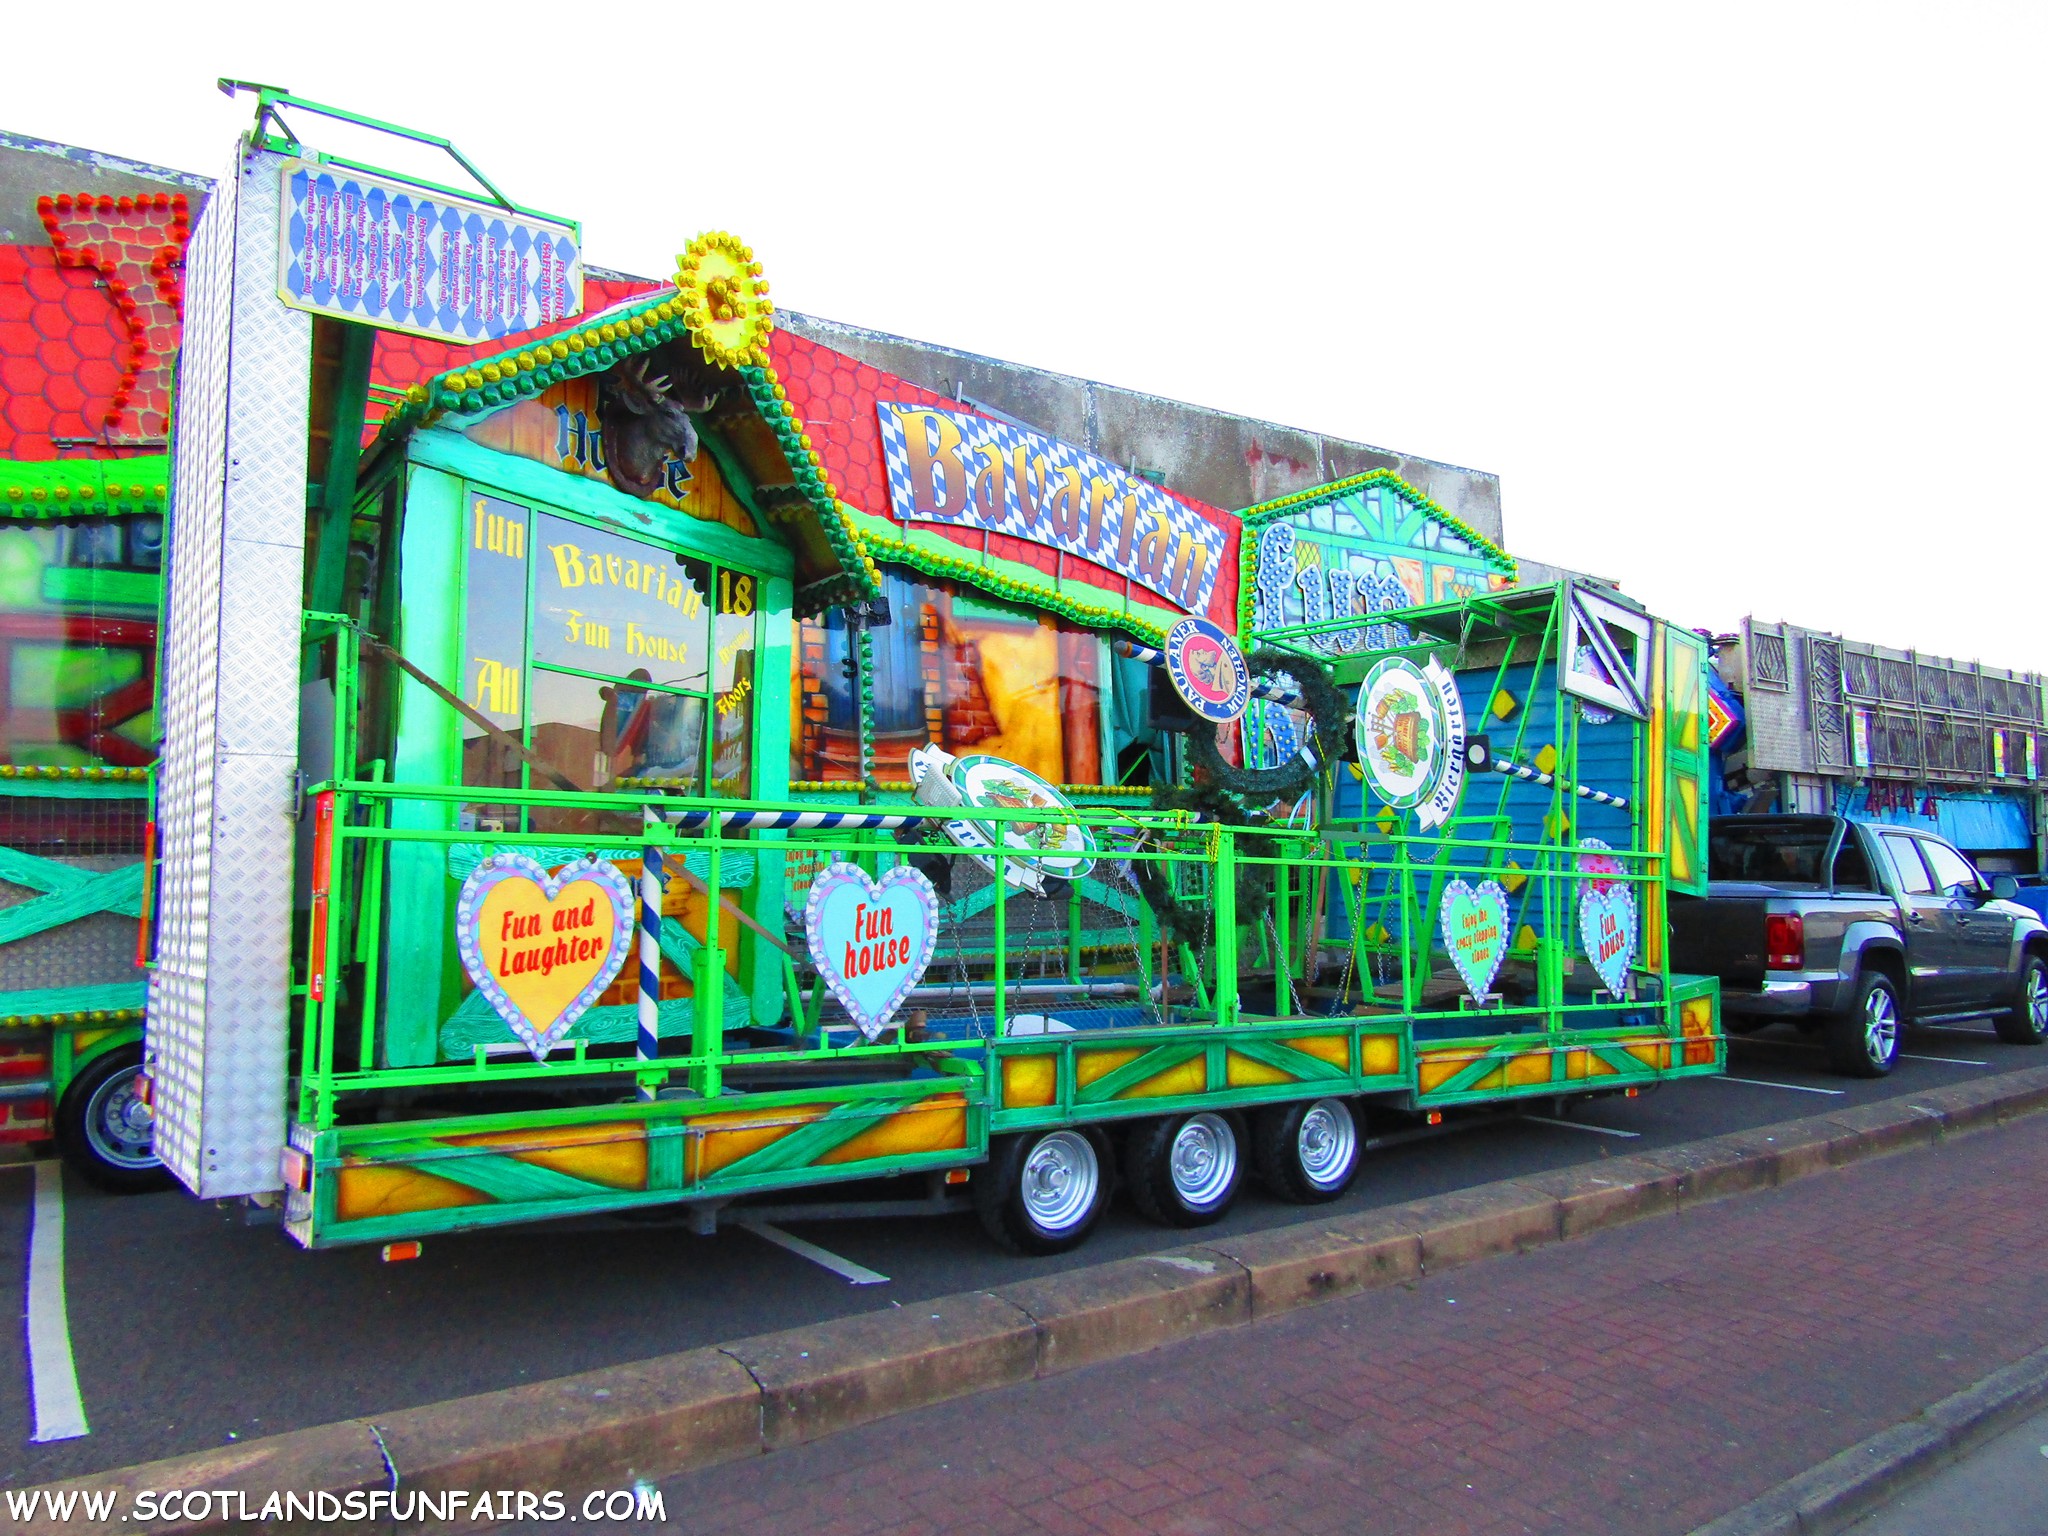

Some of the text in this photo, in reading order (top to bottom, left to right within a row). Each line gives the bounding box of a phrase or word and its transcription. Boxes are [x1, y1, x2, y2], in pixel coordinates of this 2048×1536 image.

[542, 242, 552, 292] SAFETY
[555, 260, 565, 285] FUN
[891, 404, 1207, 607] Bavarian
[474, 500, 524, 560] fun
[548, 543, 702, 620] Bavarian
[721, 571, 752, 617] 18
[565, 609, 610, 649] Fun
[468, 657, 519, 715] All
[1169, 620, 1206, 712] PAULANER
[715, 677, 752, 720] Floors
[1434, 681, 1465, 812] Biergarten
[501, 897, 595, 942] Fun and
[855, 902, 894, 943] Fun
[1599, 913, 1616, 939] Fun
[843, 935, 911, 980] house
[1598, 929, 1625, 964] house
